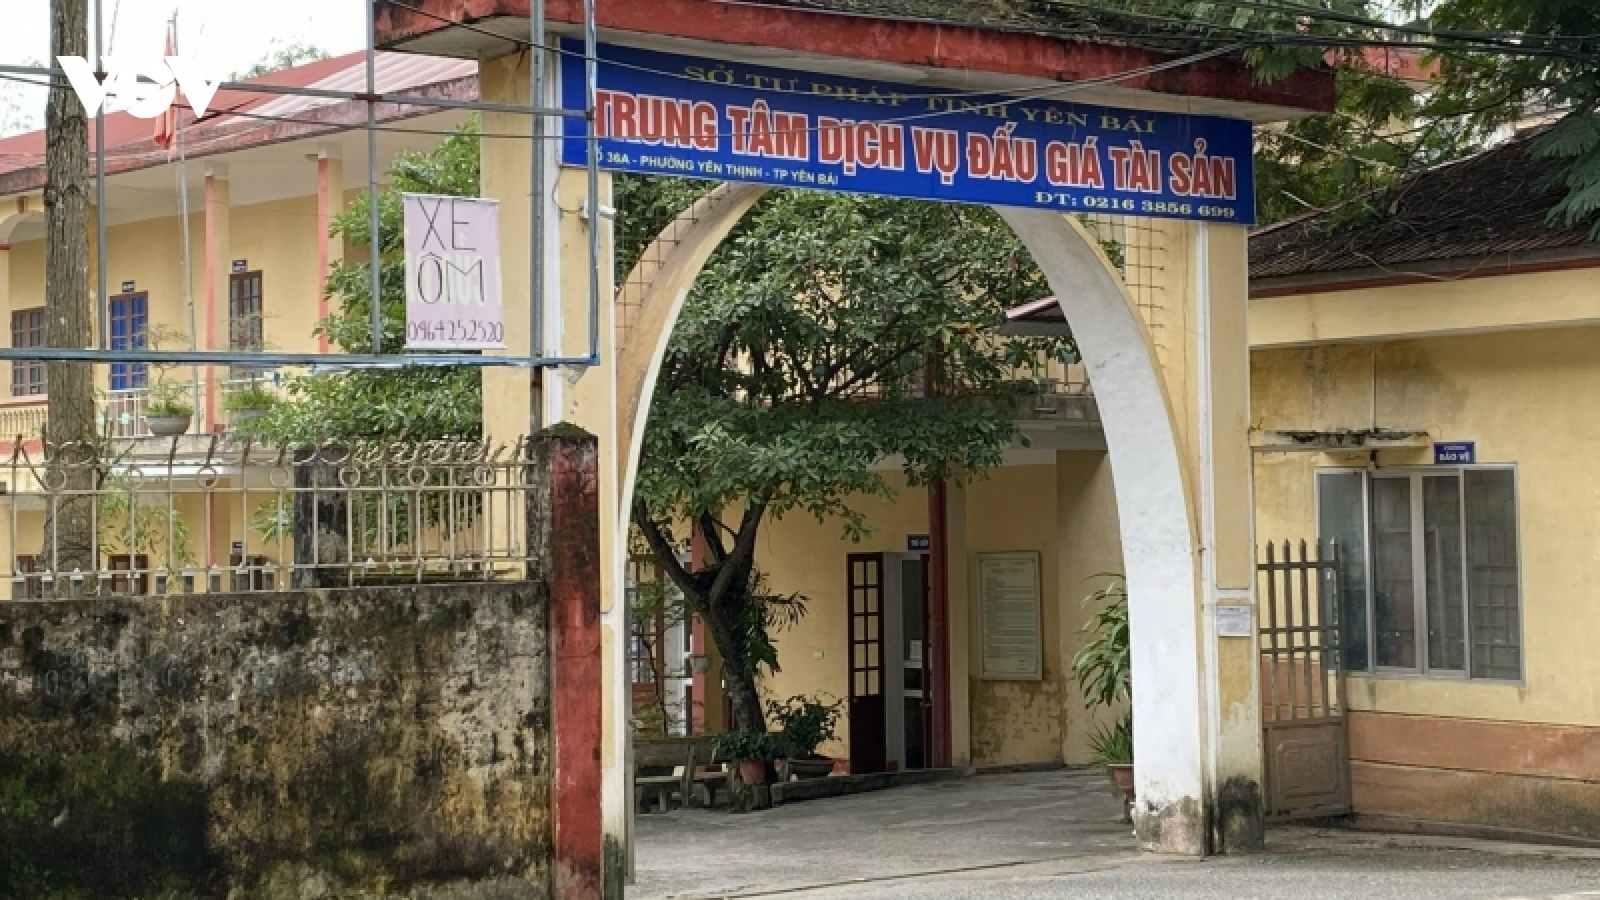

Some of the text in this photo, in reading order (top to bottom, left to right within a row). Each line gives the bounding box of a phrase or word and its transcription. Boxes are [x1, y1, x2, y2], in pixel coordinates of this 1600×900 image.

[1020, 106, 1089, 127] YÊN
[1100, 115, 1158, 133] BÁI
[596, 89, 1236, 200] TRUNG TÂM DỊCH VỤ ĐẤU GIÁ TÀI SẢN
[698, 160, 723, 174] YÊN
[726, 164, 763, 178] THỊNH
[774, 168, 788, 179] TP
[791, 169, 815, 183] YÊN
[1083, 195, 1135, 210] 0216
[417, 198, 477, 252] XE
[417, 252, 486, 305] ÔM
